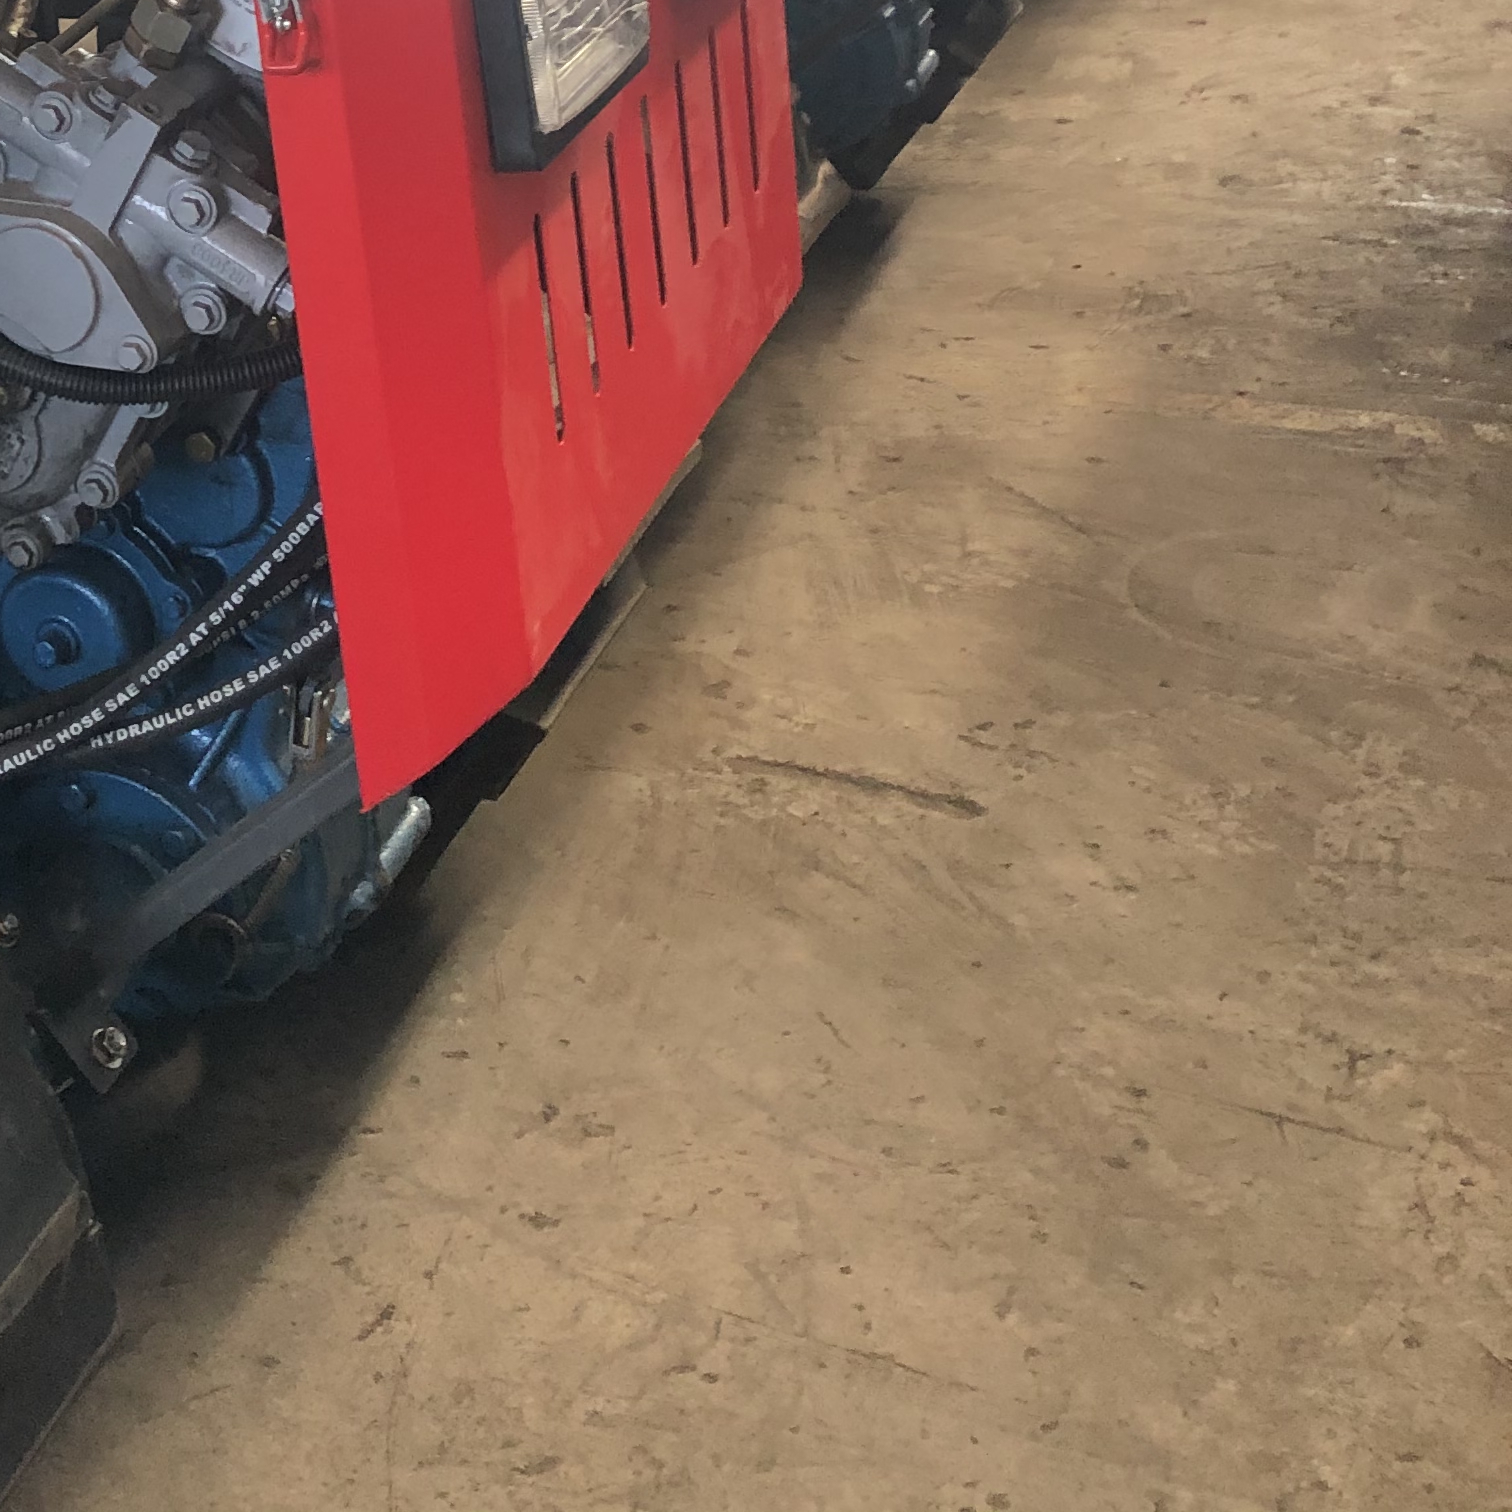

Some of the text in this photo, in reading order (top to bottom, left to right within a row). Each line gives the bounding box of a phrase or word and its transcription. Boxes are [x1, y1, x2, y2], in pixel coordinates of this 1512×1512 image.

[56, 707, 106, 744] HOSE
[104, 683, 140, 713] SAE
[139, 643, 189, 686] 100R2
[188, 621, 210, 647] AT
[208, 584, 247, 626] 5/16"
[247, 560, 273, 587] WP
[89, 619, 332, 750] HYDRAULIC HOSE SAE 100R2
